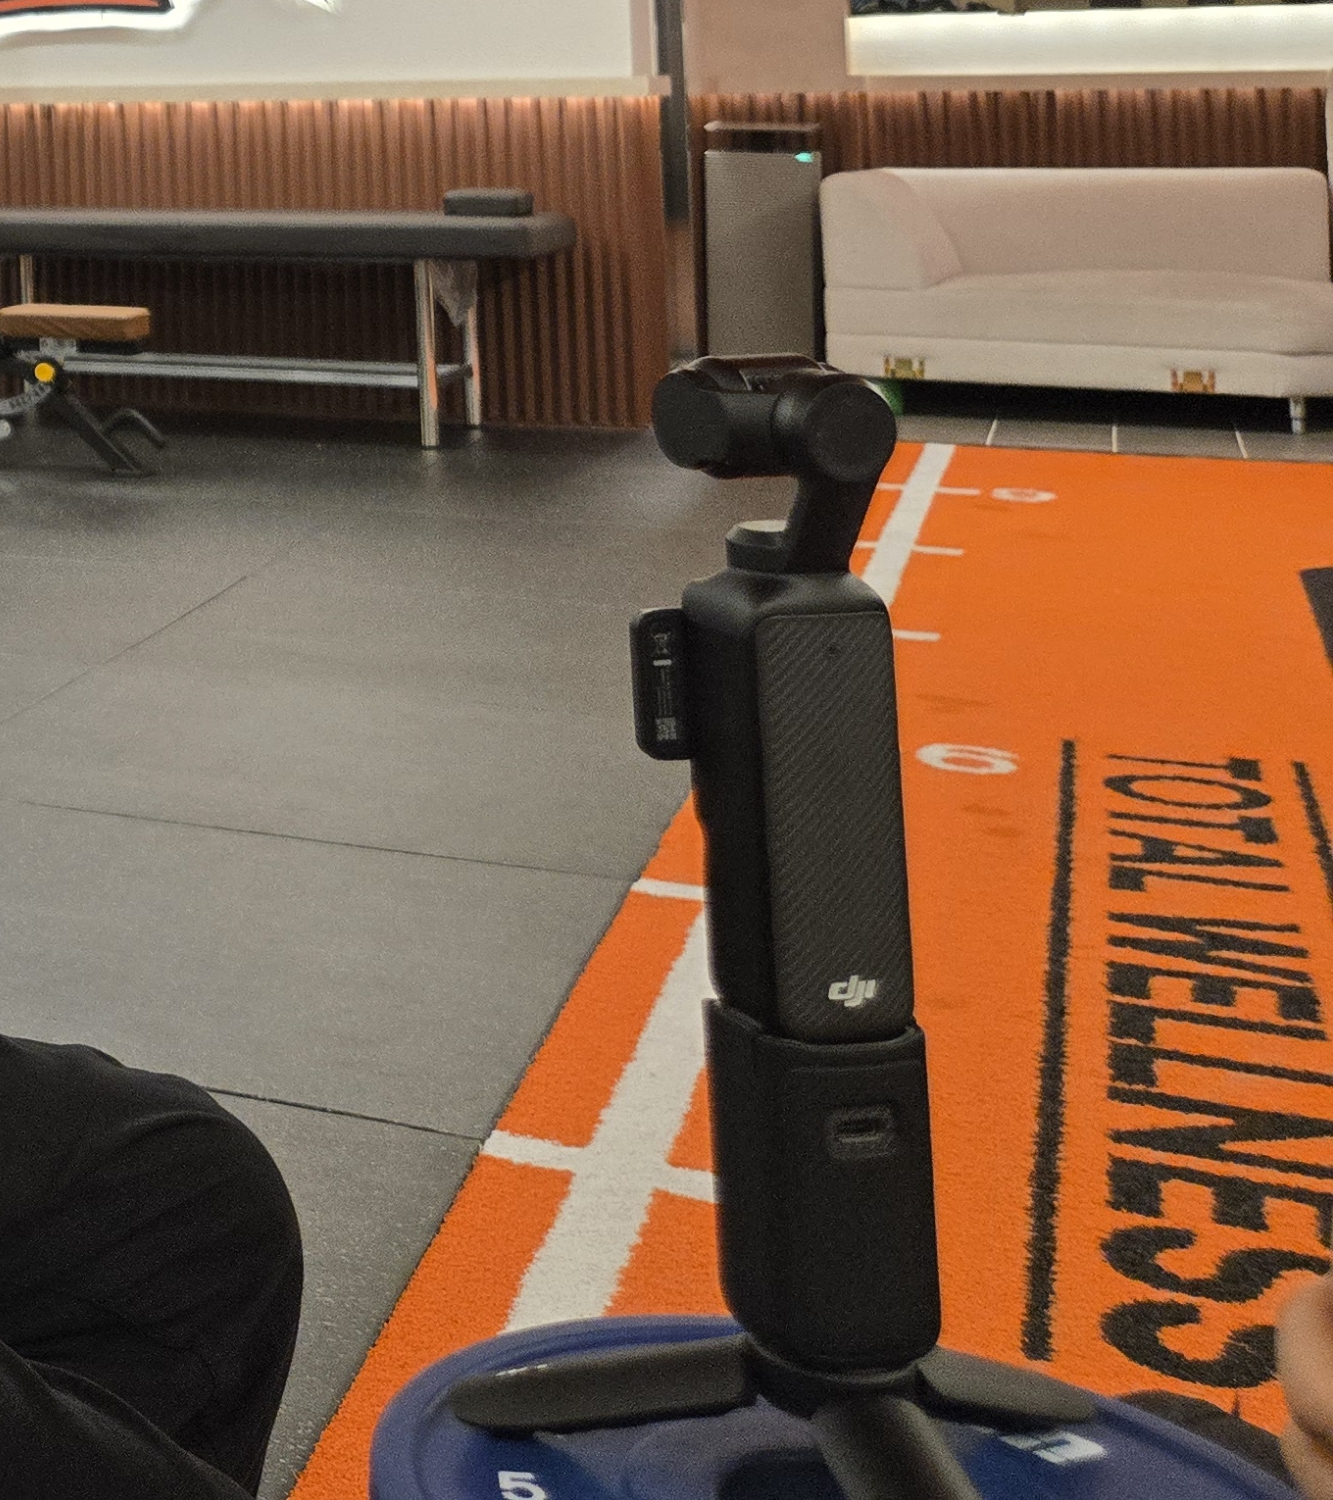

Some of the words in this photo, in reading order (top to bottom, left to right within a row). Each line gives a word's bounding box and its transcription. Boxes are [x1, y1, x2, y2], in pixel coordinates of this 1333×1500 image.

[1103, 753, 1292, 894] TOTAL
[827, 974, 876, 1008] dji
[1099, 910, 1333, 1388] WELLNESS
